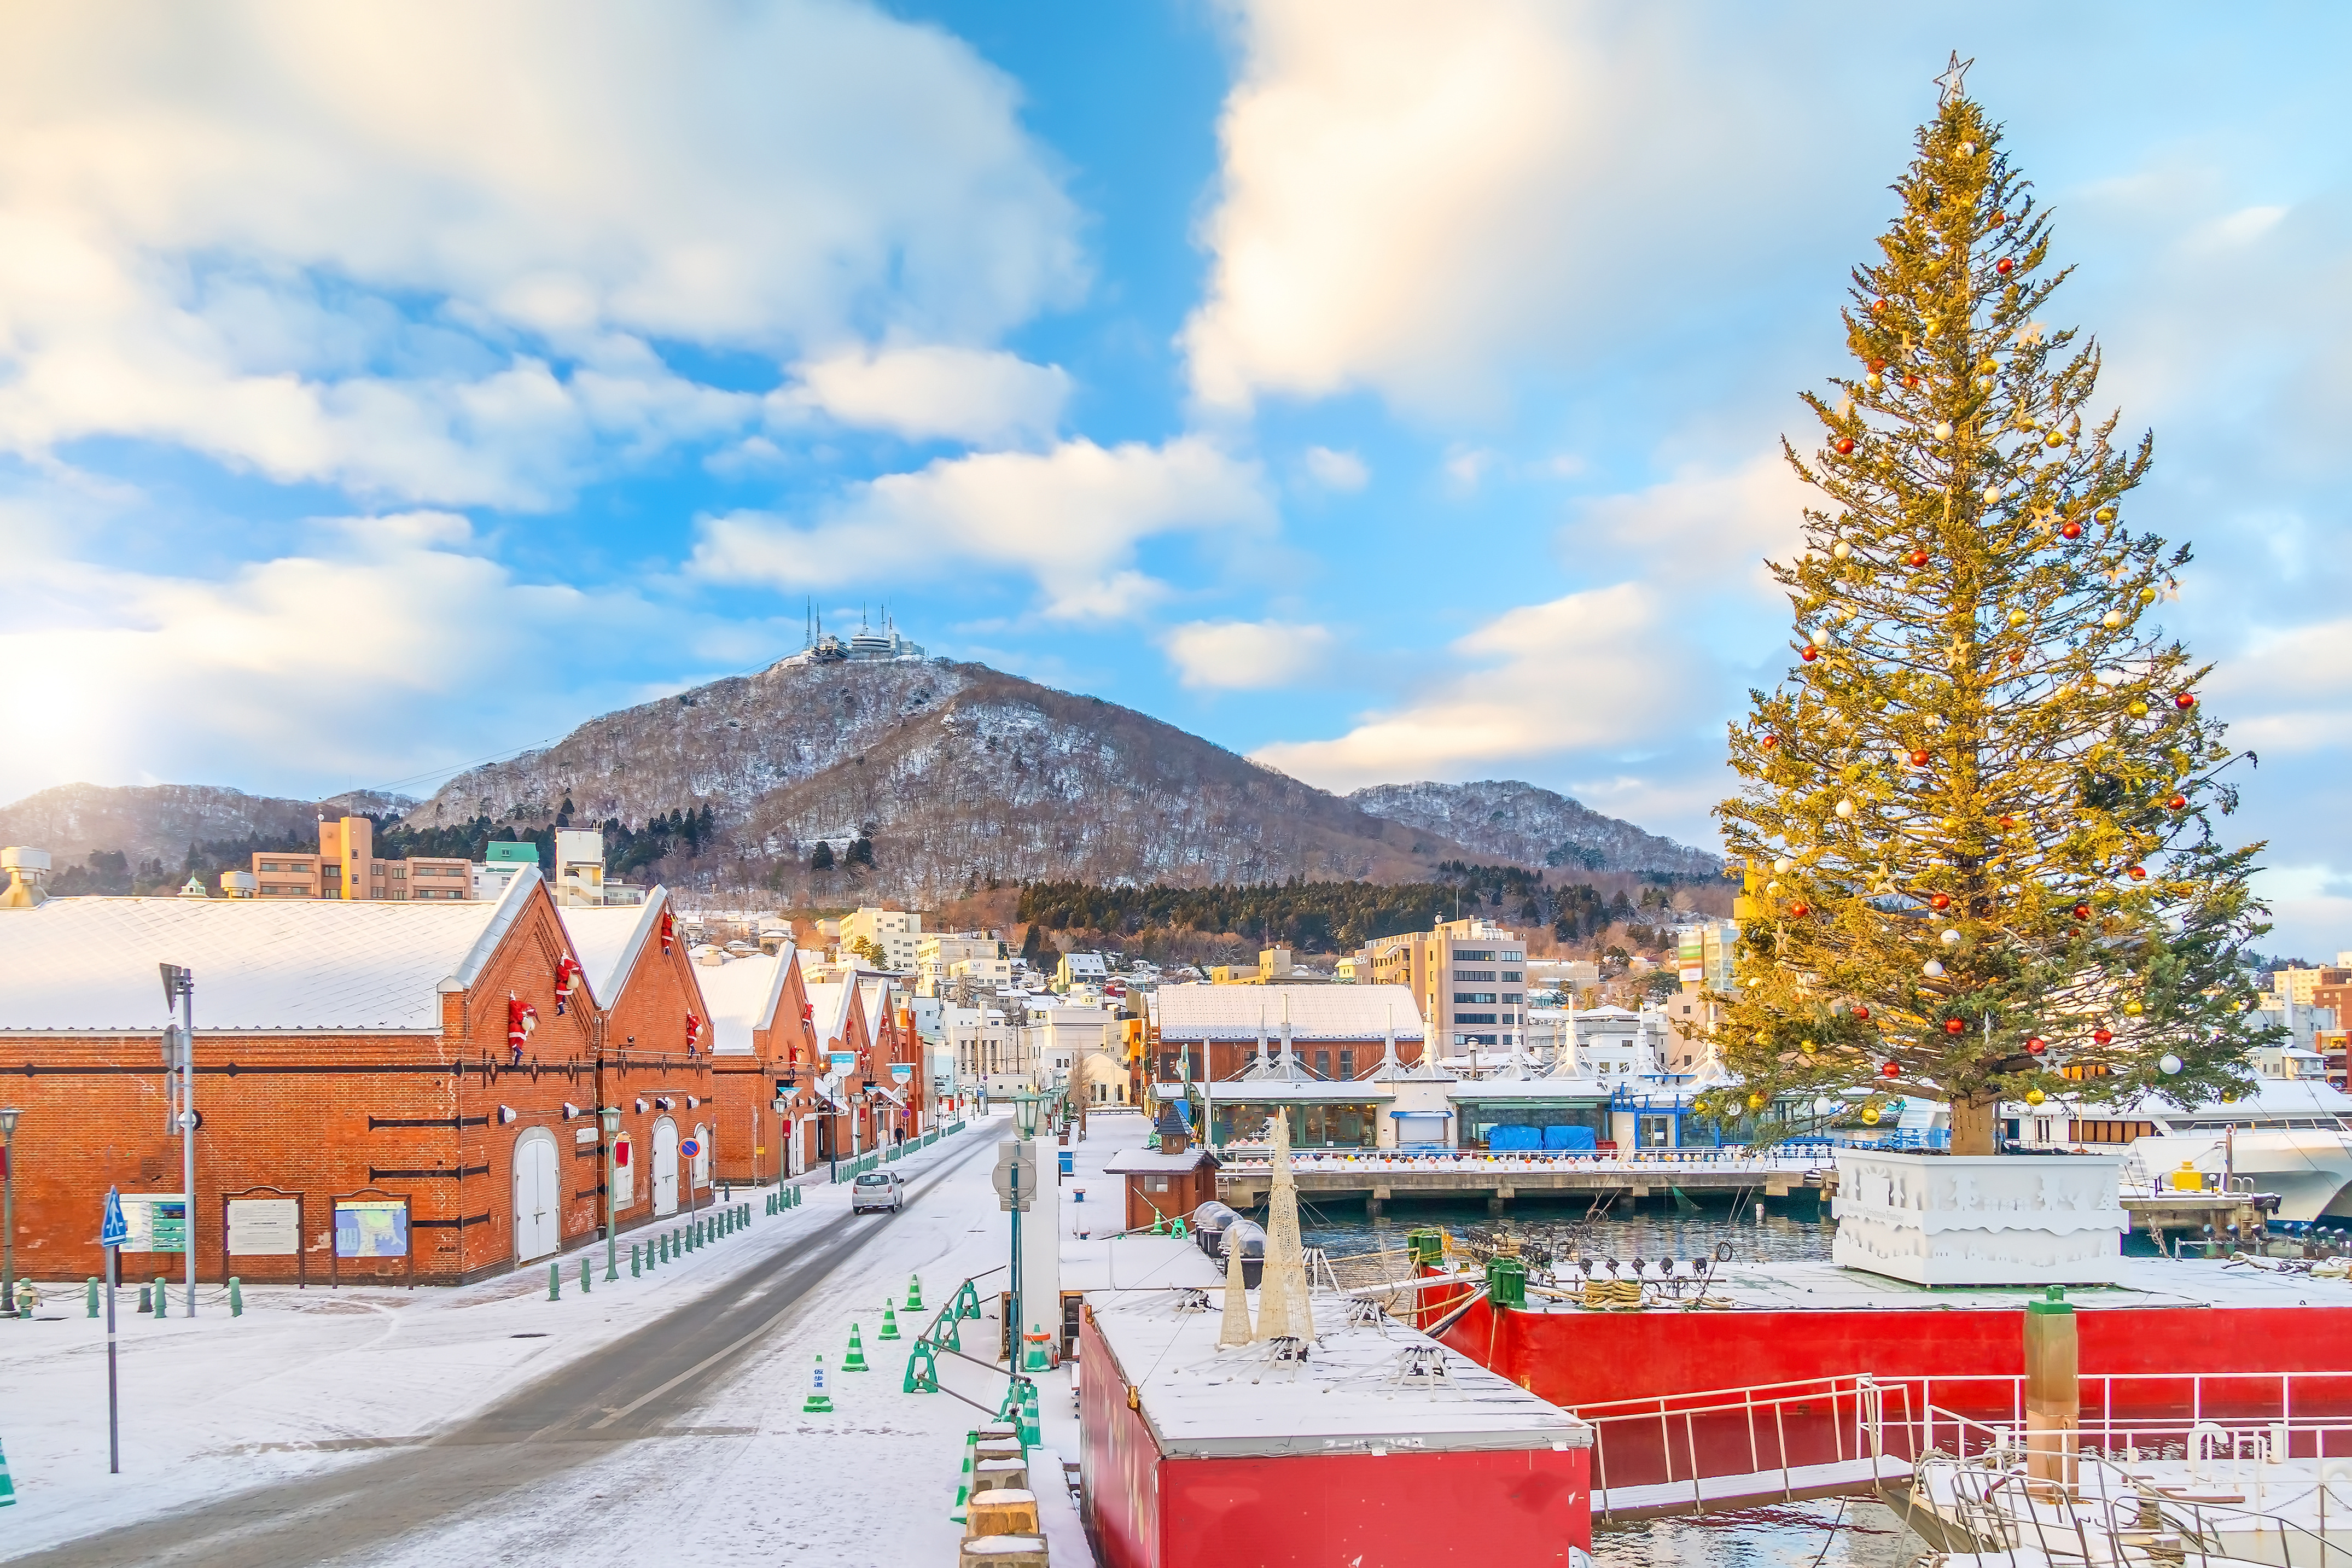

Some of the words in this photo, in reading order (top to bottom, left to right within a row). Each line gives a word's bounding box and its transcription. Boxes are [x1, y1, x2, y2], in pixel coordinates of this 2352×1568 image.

[1355, 954, 1367, 965] SEC
[1864, 1206, 1886, 1219] Christmas
[1887, 1210, 1904, 1223] Fantasy
[814, 1369, 823, 1388] 仮歩道
